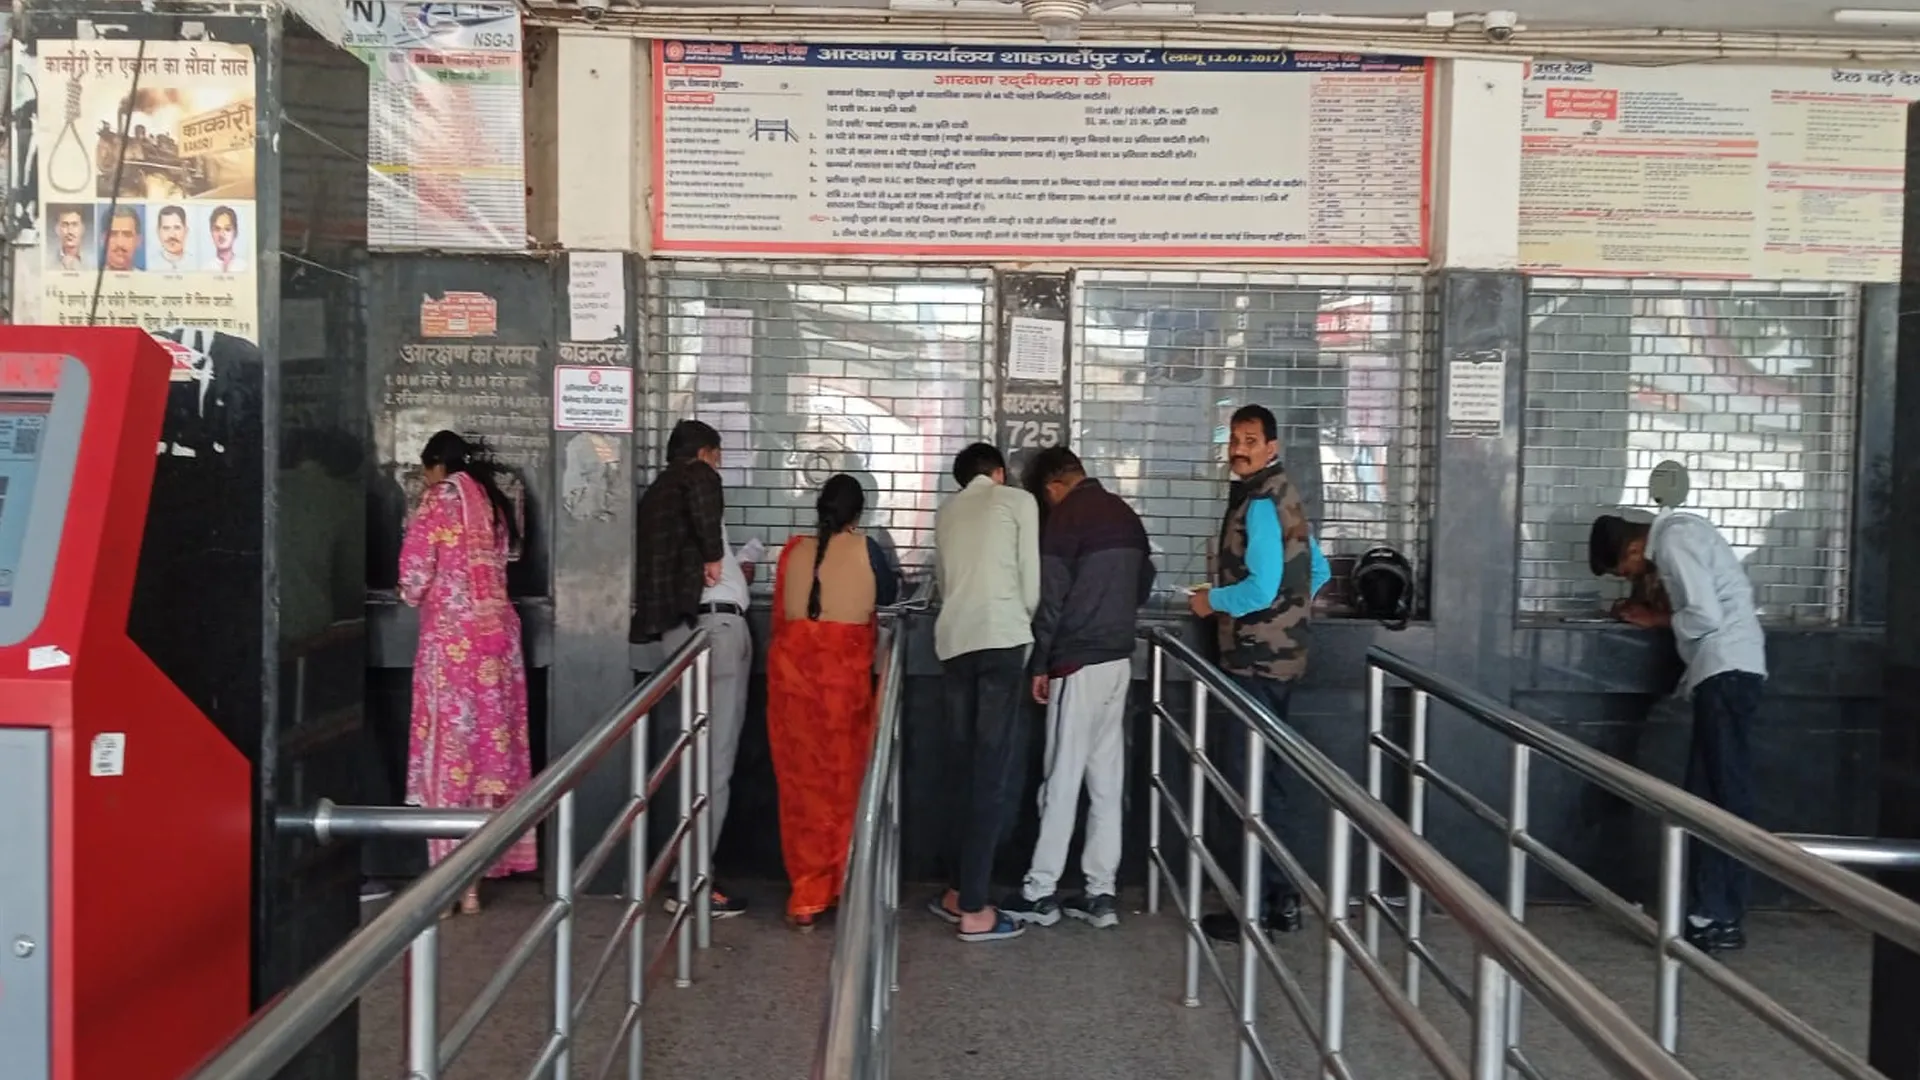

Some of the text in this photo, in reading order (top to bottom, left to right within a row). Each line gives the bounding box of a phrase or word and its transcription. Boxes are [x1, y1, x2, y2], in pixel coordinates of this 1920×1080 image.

[473, 31, 514, 47] NSG-3
[45, 50, 88, 76] काकोरी
[94, 51, 113, 79] ट्रेन
[163, 57, 179, 75] का
[185, 48, 216, 75] सौवां
[221, 58, 248, 76] साल
[817, 48, 896, 62] आरक्षण
[902, 47, 993, 63] कार्यालय
[1161, 51, 1206, 66] (लागू
[1208, 51, 1287, 66] 12.01.2017)
[934, 74, 993, 86] आरक्षण
[1084, 73, 1102, 87] के
[182, 104, 253, 138] काकोरी
[400, 344, 540, 366] आरक्षण का समय
[1006, 420, 1060, 448] 725
